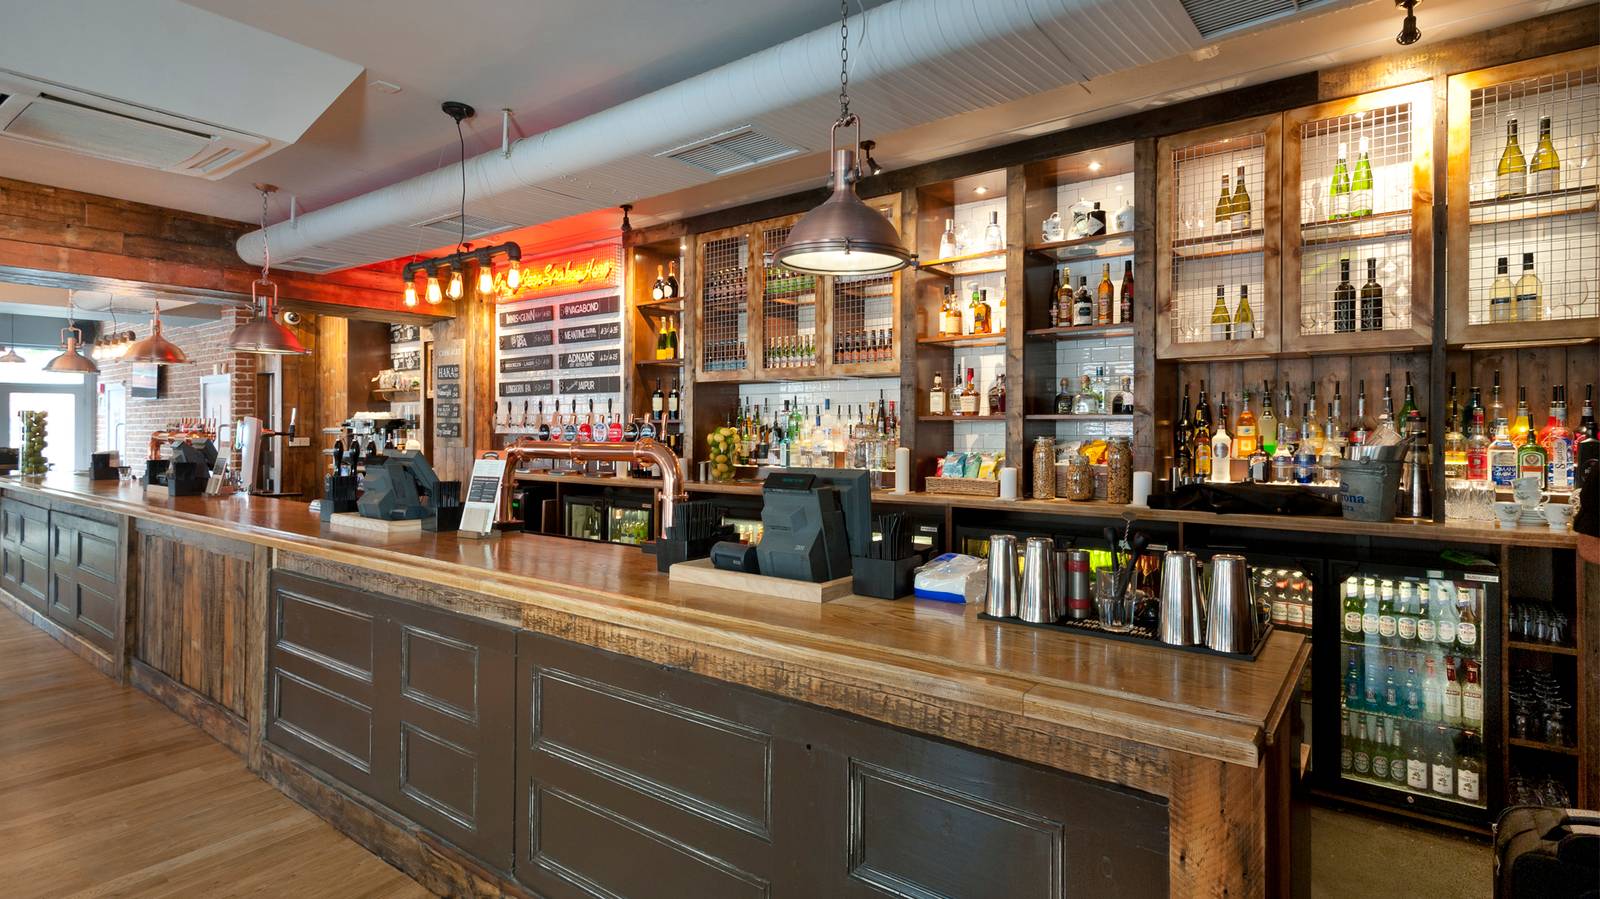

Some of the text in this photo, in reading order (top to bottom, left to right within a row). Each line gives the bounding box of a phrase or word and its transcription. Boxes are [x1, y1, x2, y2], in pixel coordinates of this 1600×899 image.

[569, 301, 599, 315] VAGABOND
[564, 329, 586, 340] MEANTIME
[567, 352, 595, 363] ADNAMS
[438, 366, 454, 379] HAKA
[578, 380, 595, 391] JAIPUR
